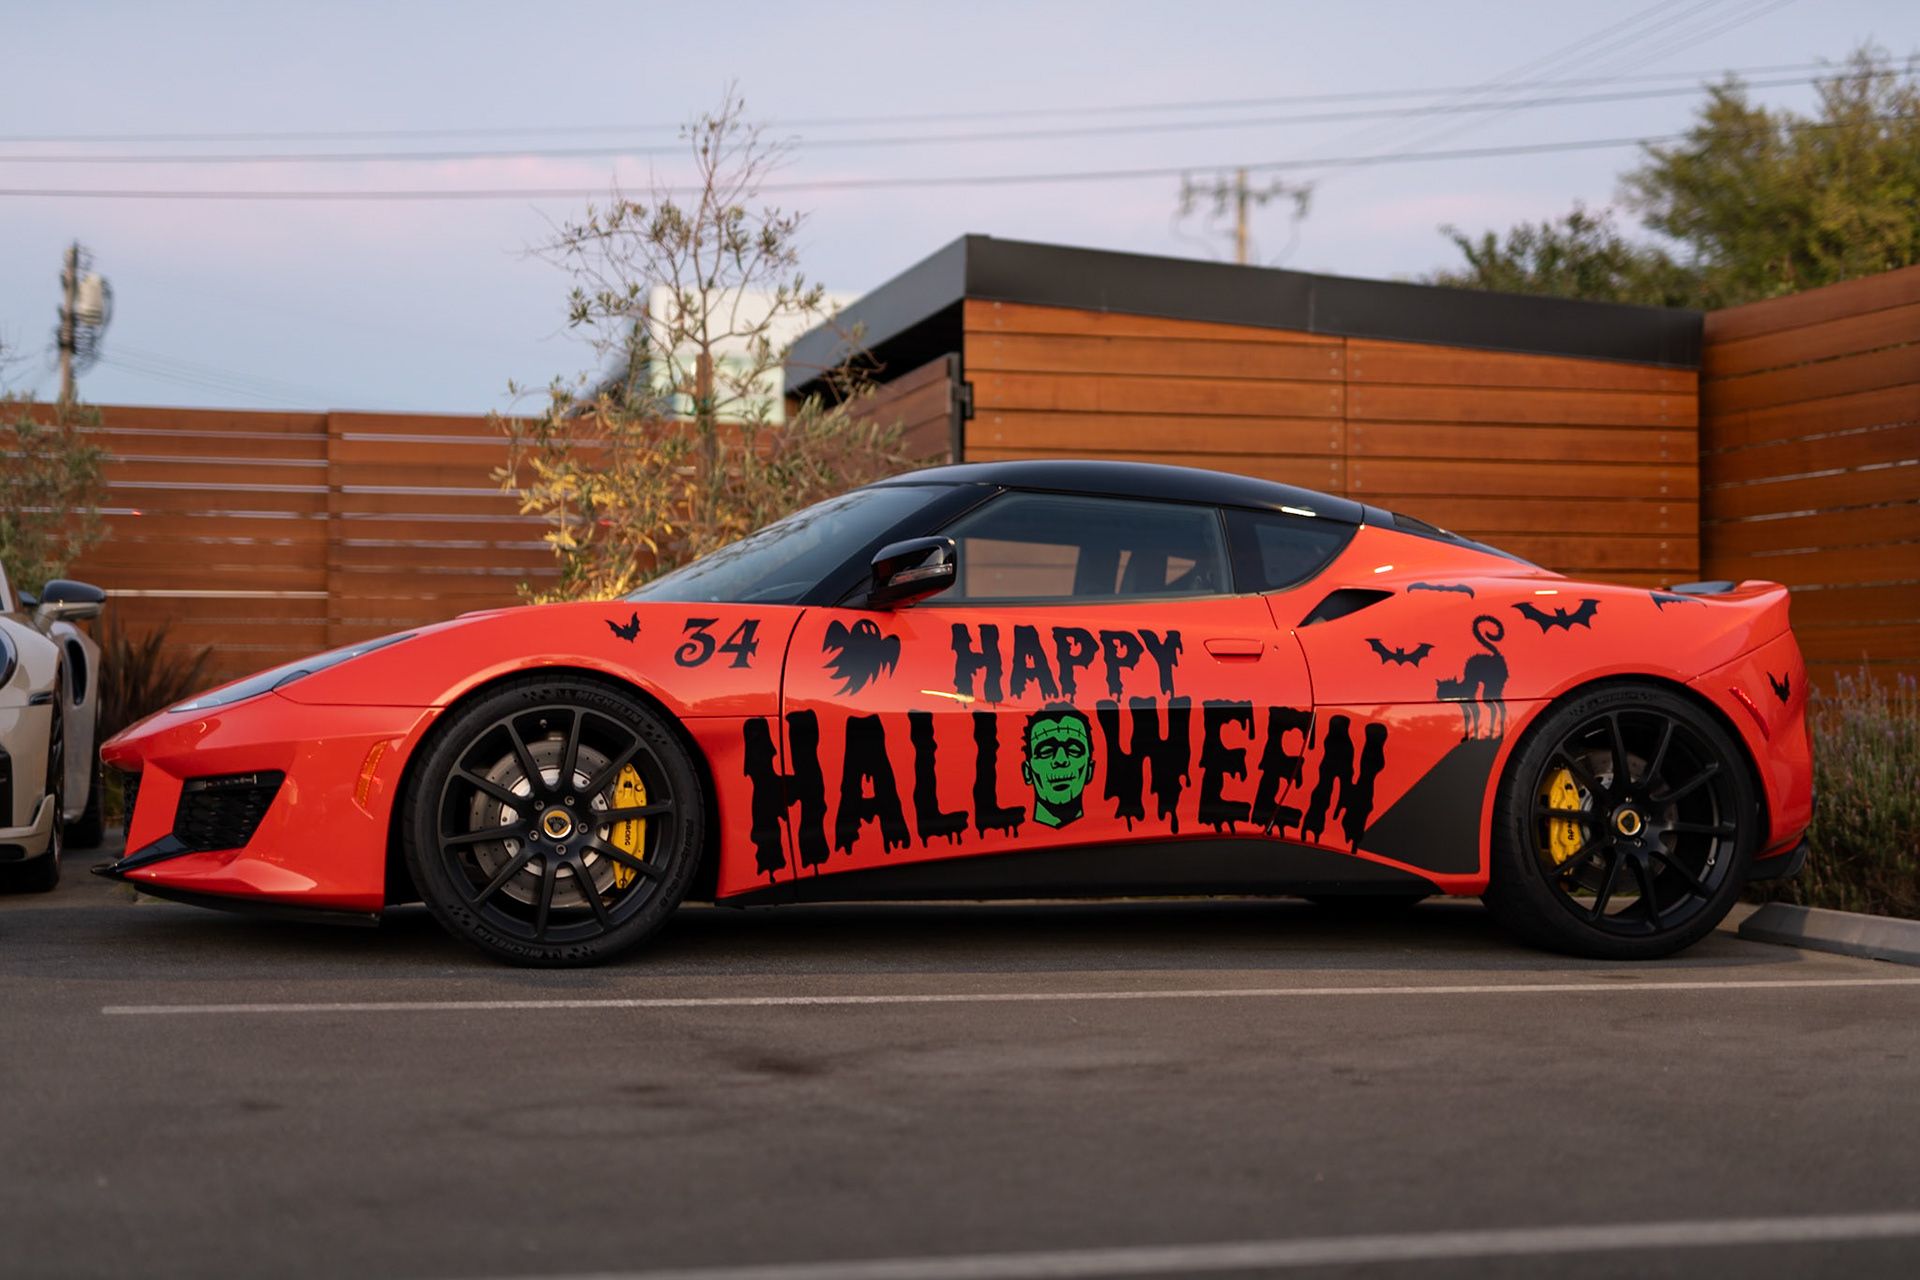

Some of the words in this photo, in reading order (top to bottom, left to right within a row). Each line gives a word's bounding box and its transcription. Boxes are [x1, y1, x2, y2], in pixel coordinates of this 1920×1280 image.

[674, 618, 760, 669] 34
[951, 623, 1183, 709] HAPPY
[575, 690, 642, 723] MICHELIN
